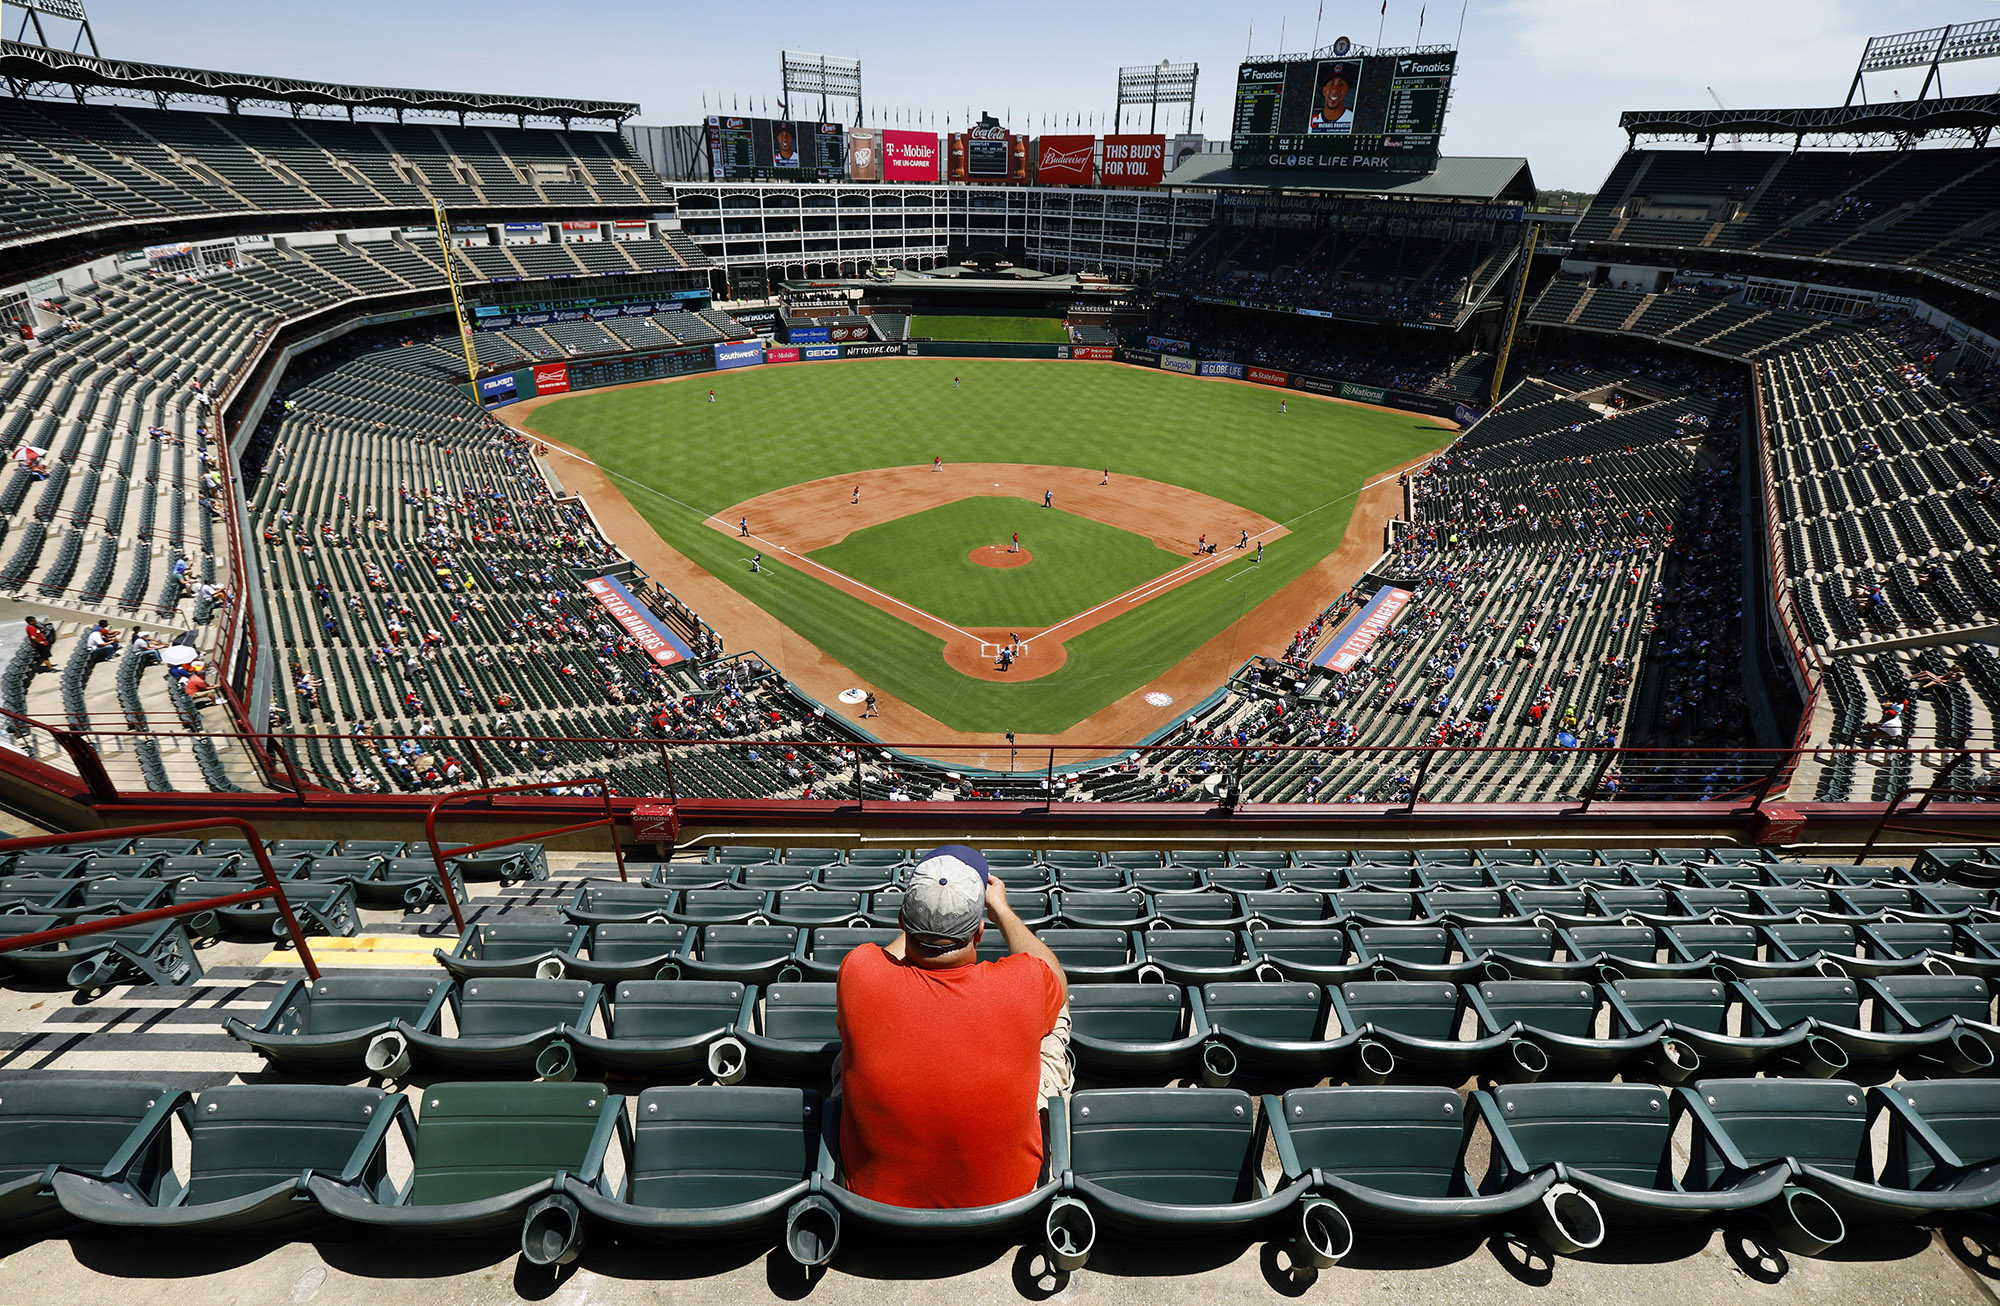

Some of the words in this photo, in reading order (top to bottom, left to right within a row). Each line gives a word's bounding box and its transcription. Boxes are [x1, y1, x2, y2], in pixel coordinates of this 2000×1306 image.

[1411, 62, 1450, 72] Fanatics
[1252, 70, 1284, 80] Fanatics
[1106, 145, 1128, 159] THIS
[1130, 145, 1162, 159] BUD'S
[1044, 154, 1088, 164] Budweiser
[1319, 155, 1348, 166] LIFE
[1352, 156, 1389, 167] PARK
[1104, 162, 1124, 174] FOR
[1126, 162, 1149, 175] YOU.
[720, 350, 754, 361] Southwest
[806, 349, 838, 357] GEICO
[848, 345, 901, 355] NITTOTIRE.COM
[1164, 357, 1192, 370] Snapple
[1209, 364, 1228, 374] GLOBE
[1230, 366, 1241, 376] LIFE
[1351, 388, 1384, 399] National
[600, 593, 632, 617] TEXAS
[622, 615, 665, 650] RANGERS
[1345, 626, 1378, 652] TEXAS
[1366, 599, 1401, 630] RANGERS
